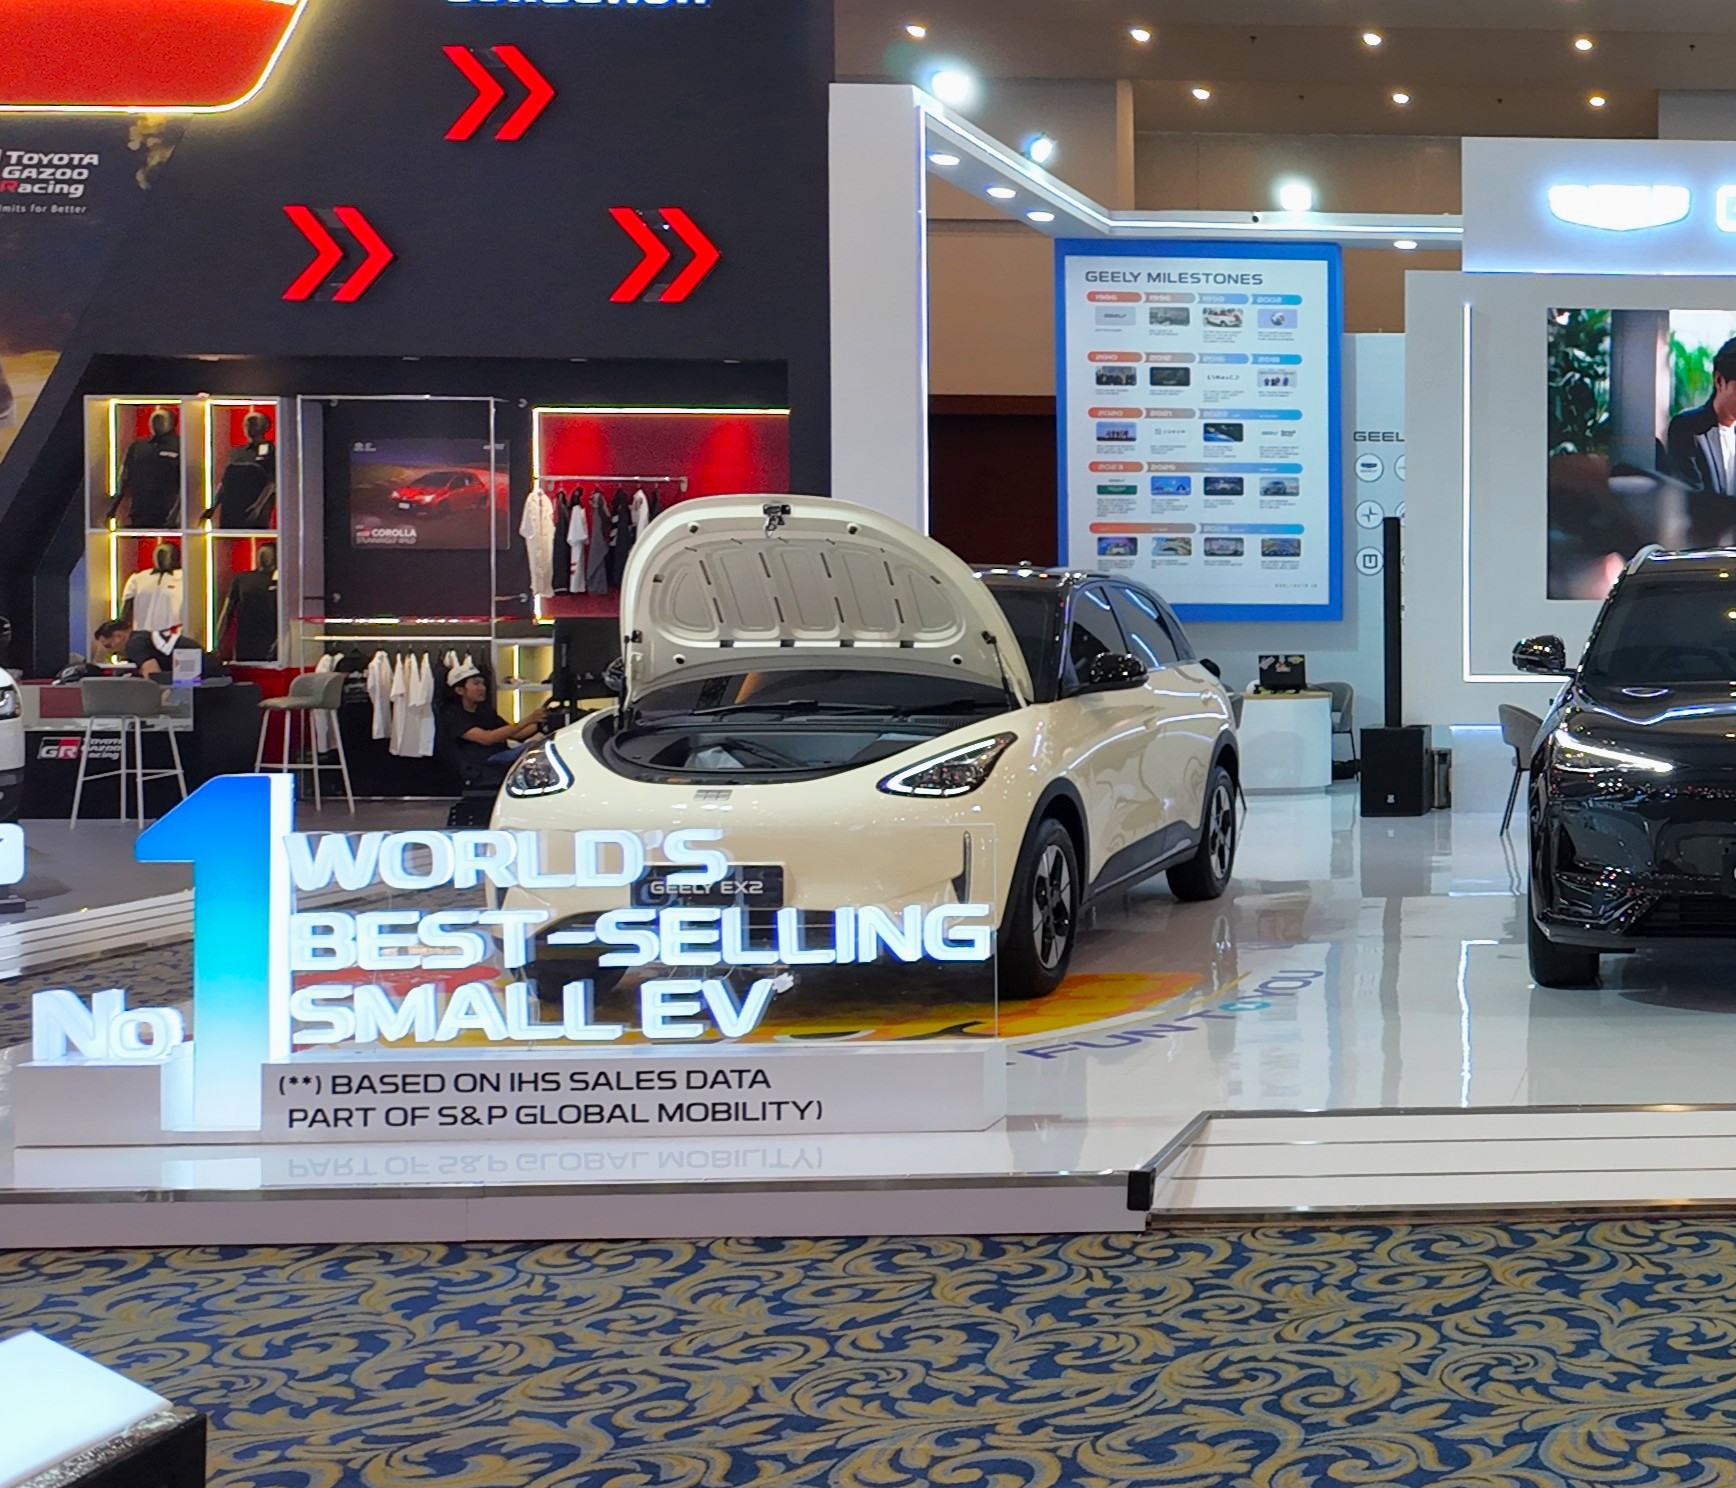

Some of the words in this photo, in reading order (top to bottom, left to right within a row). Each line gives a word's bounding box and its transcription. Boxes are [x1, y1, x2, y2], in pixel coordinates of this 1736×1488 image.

[6, 151, 99, 165] TOYOTA
[2, 166, 89, 179] GAZOO
[0, 181, 84, 198] Racing
[30, 203, 47, 213] for
[51, 204, 87, 213] Better
[1085, 270, 1142, 283] GEELY
[1147, 272, 1263, 285] MILESTONES
[371, 529, 417, 537] COROLLA
[284, 829, 729, 891] WORLD'S
[720, 880, 764, 894] EX2
[290, 904, 993, 970] BEST-SELLING
[135, 774, 293, 1131] 1
[289, 980, 623, 1044] SMALL
[1017, 1023, 1199, 1060] FUN
[331, 1073, 446, 1095] BASED
[454, 1072, 501, 1093] ON
[510, 1071, 562, 1092] IHS
[569, 1070, 677, 1091] SALES
[686, 1069, 772, 1090] DATA
[288, 1106, 377, 1129] PART
[384, 1106, 430, 1127] OF
[438, 1105, 508, 1126] S&P
[516, 1103, 650, 1125] GLOBAL
[657, 1100, 823, 1123] MOBILITY)
